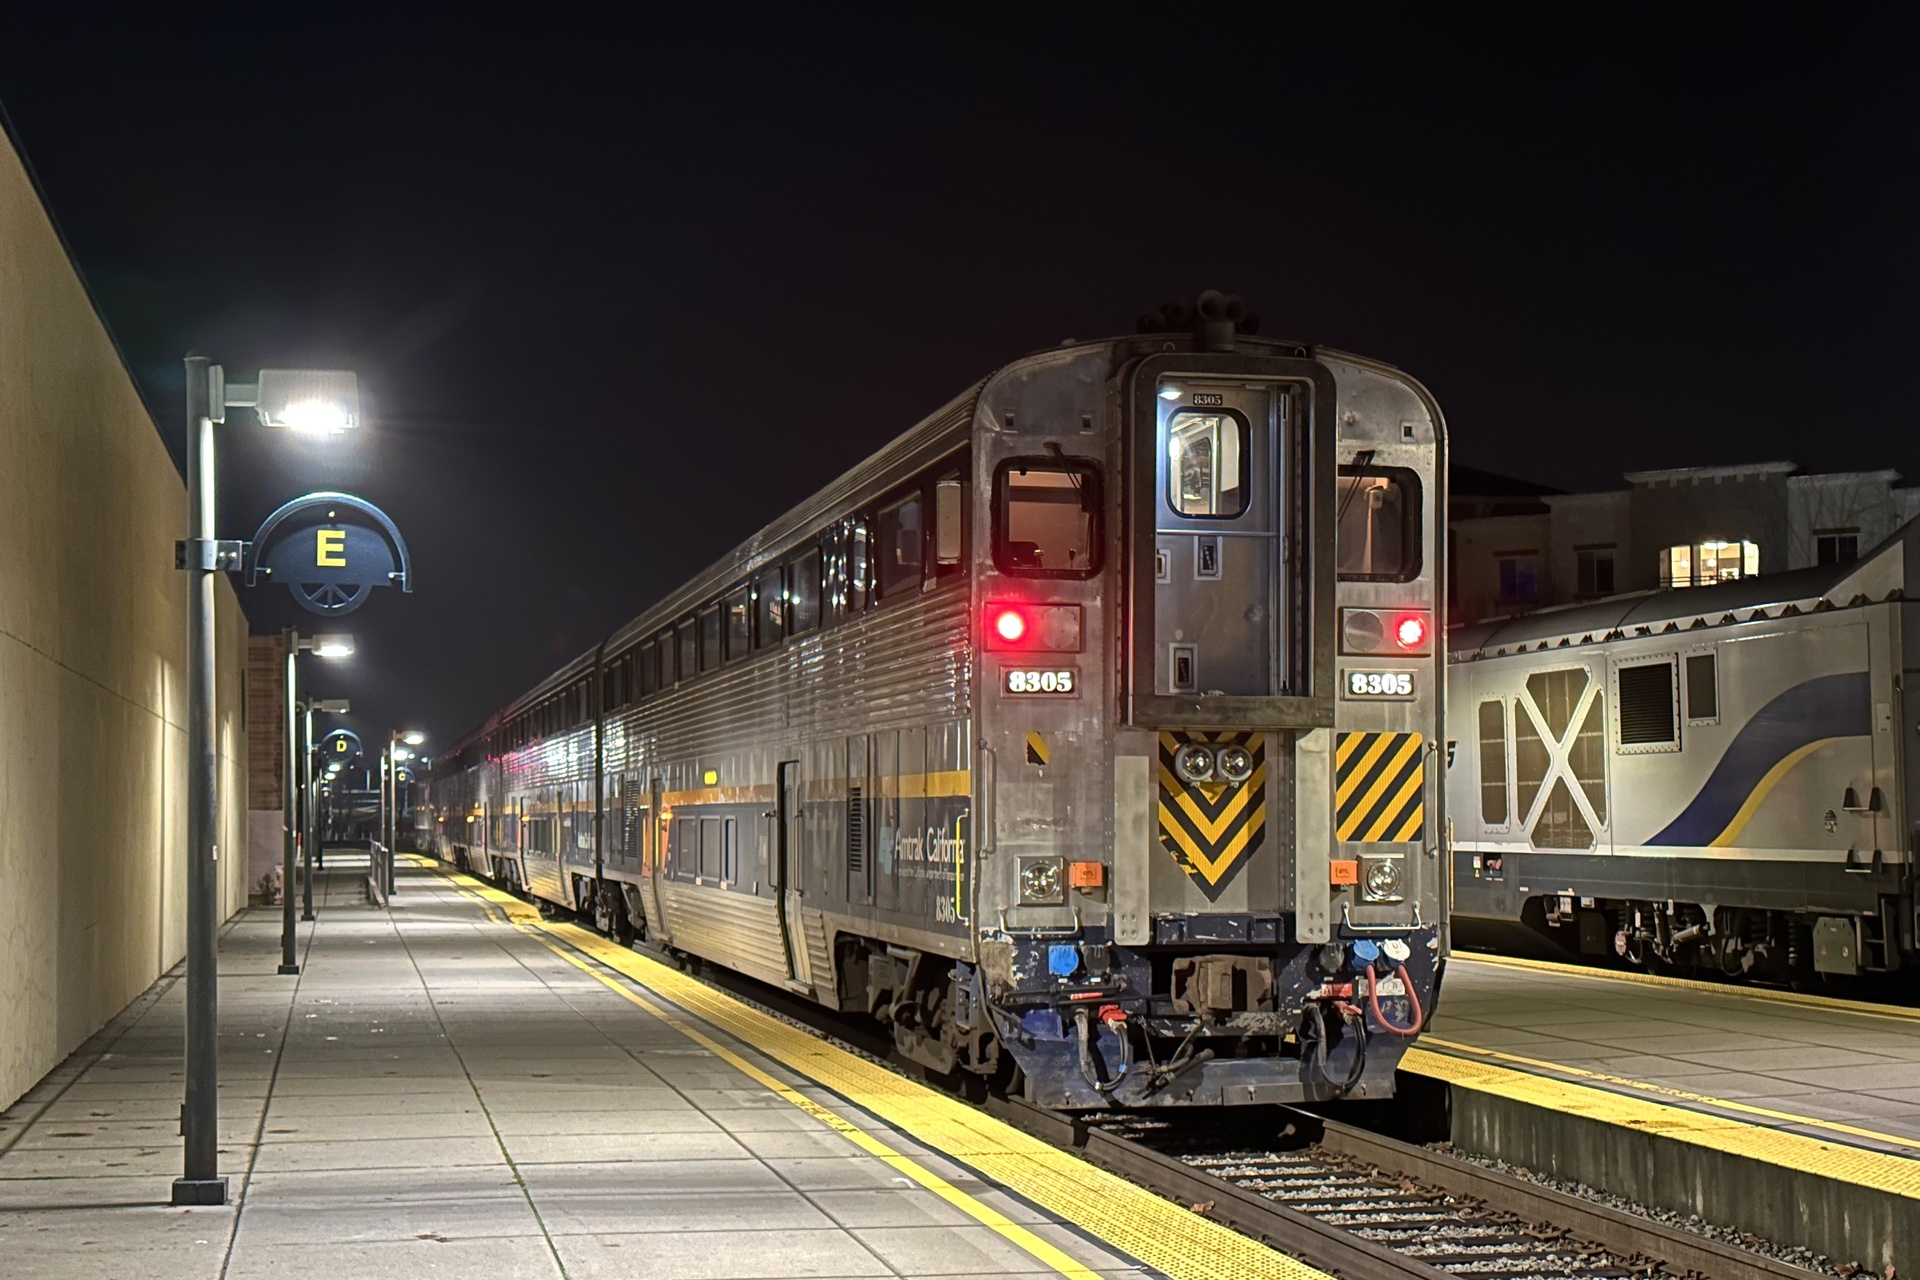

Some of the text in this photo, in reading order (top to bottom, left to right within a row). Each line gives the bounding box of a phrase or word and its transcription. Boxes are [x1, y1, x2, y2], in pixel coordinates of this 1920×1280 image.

[1194, 394, 1221, 405] 8305
[316, 529, 346, 567] E
[1008, 670, 1072, 692] 8305
[1351, 673, 1412, 695] 8305
[336, 739, 348, 753] D
[398, 772, 406, 782] C
[894, 826, 965, 864] Amtrak Californa
[935, 895, 956, 924] 8305
